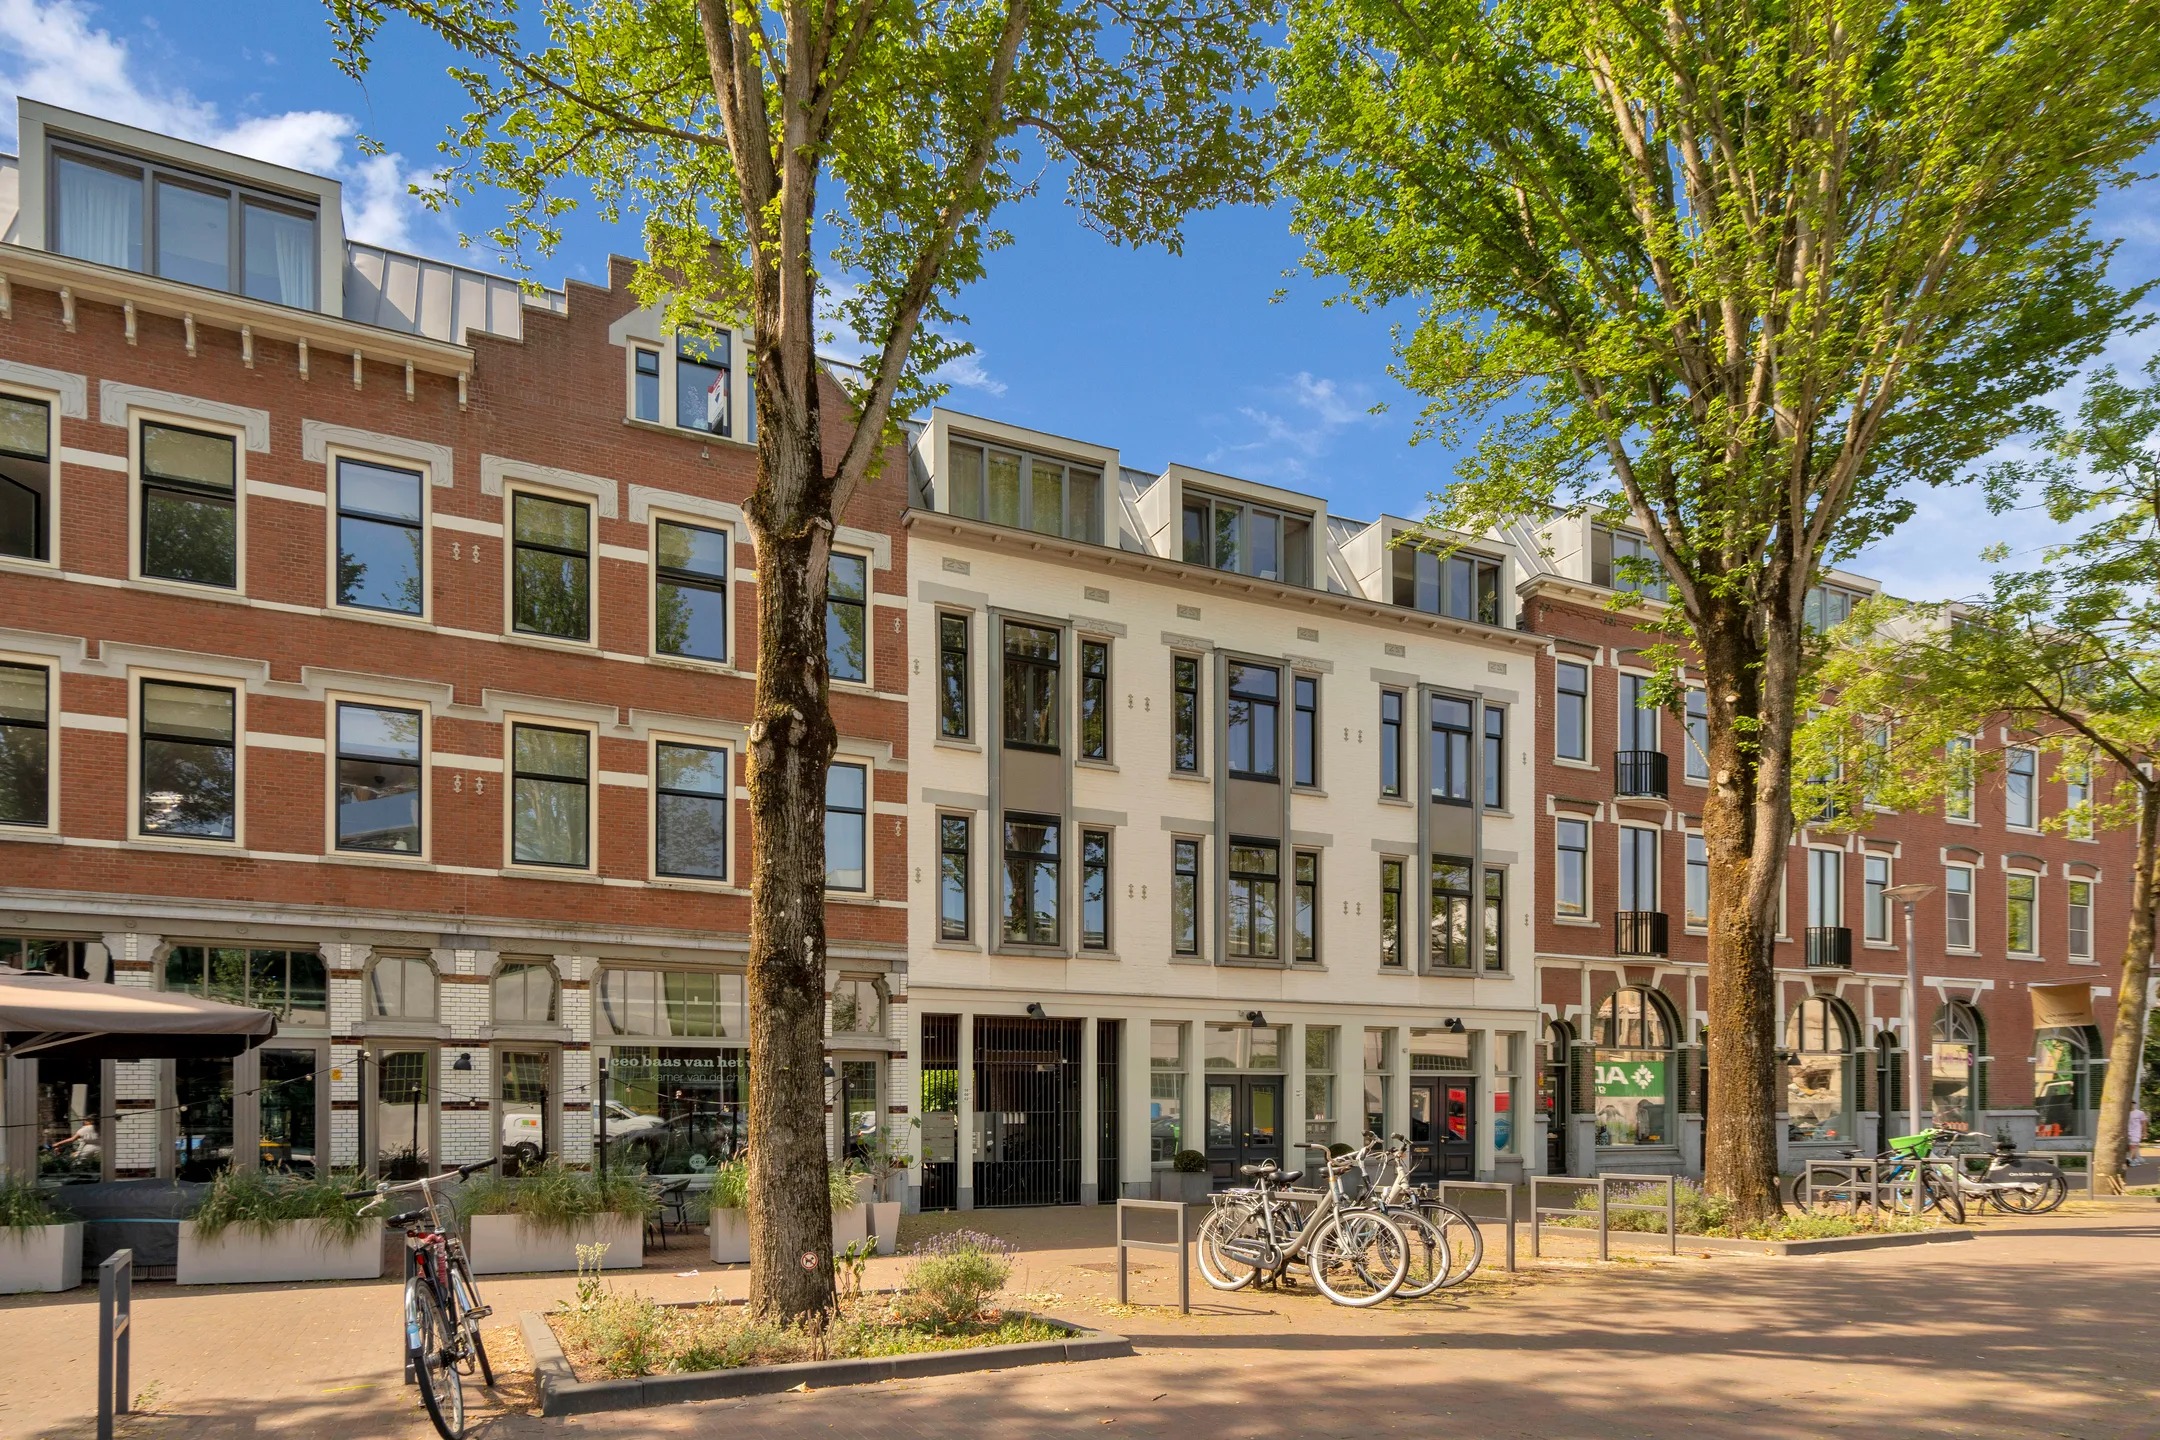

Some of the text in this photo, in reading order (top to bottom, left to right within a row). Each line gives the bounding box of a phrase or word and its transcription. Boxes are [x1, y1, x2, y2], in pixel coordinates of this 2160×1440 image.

[611, 1058, 640, 1067] ceo
[642, 1055, 682, 1067] baas
[684, 1058, 715, 1068] van
[717, 1056, 744, 1068] het
[650, 1073, 684, 1082] kamer
[687, 1073, 706, 1082] van
[709, 1072, 722, 1082] de
